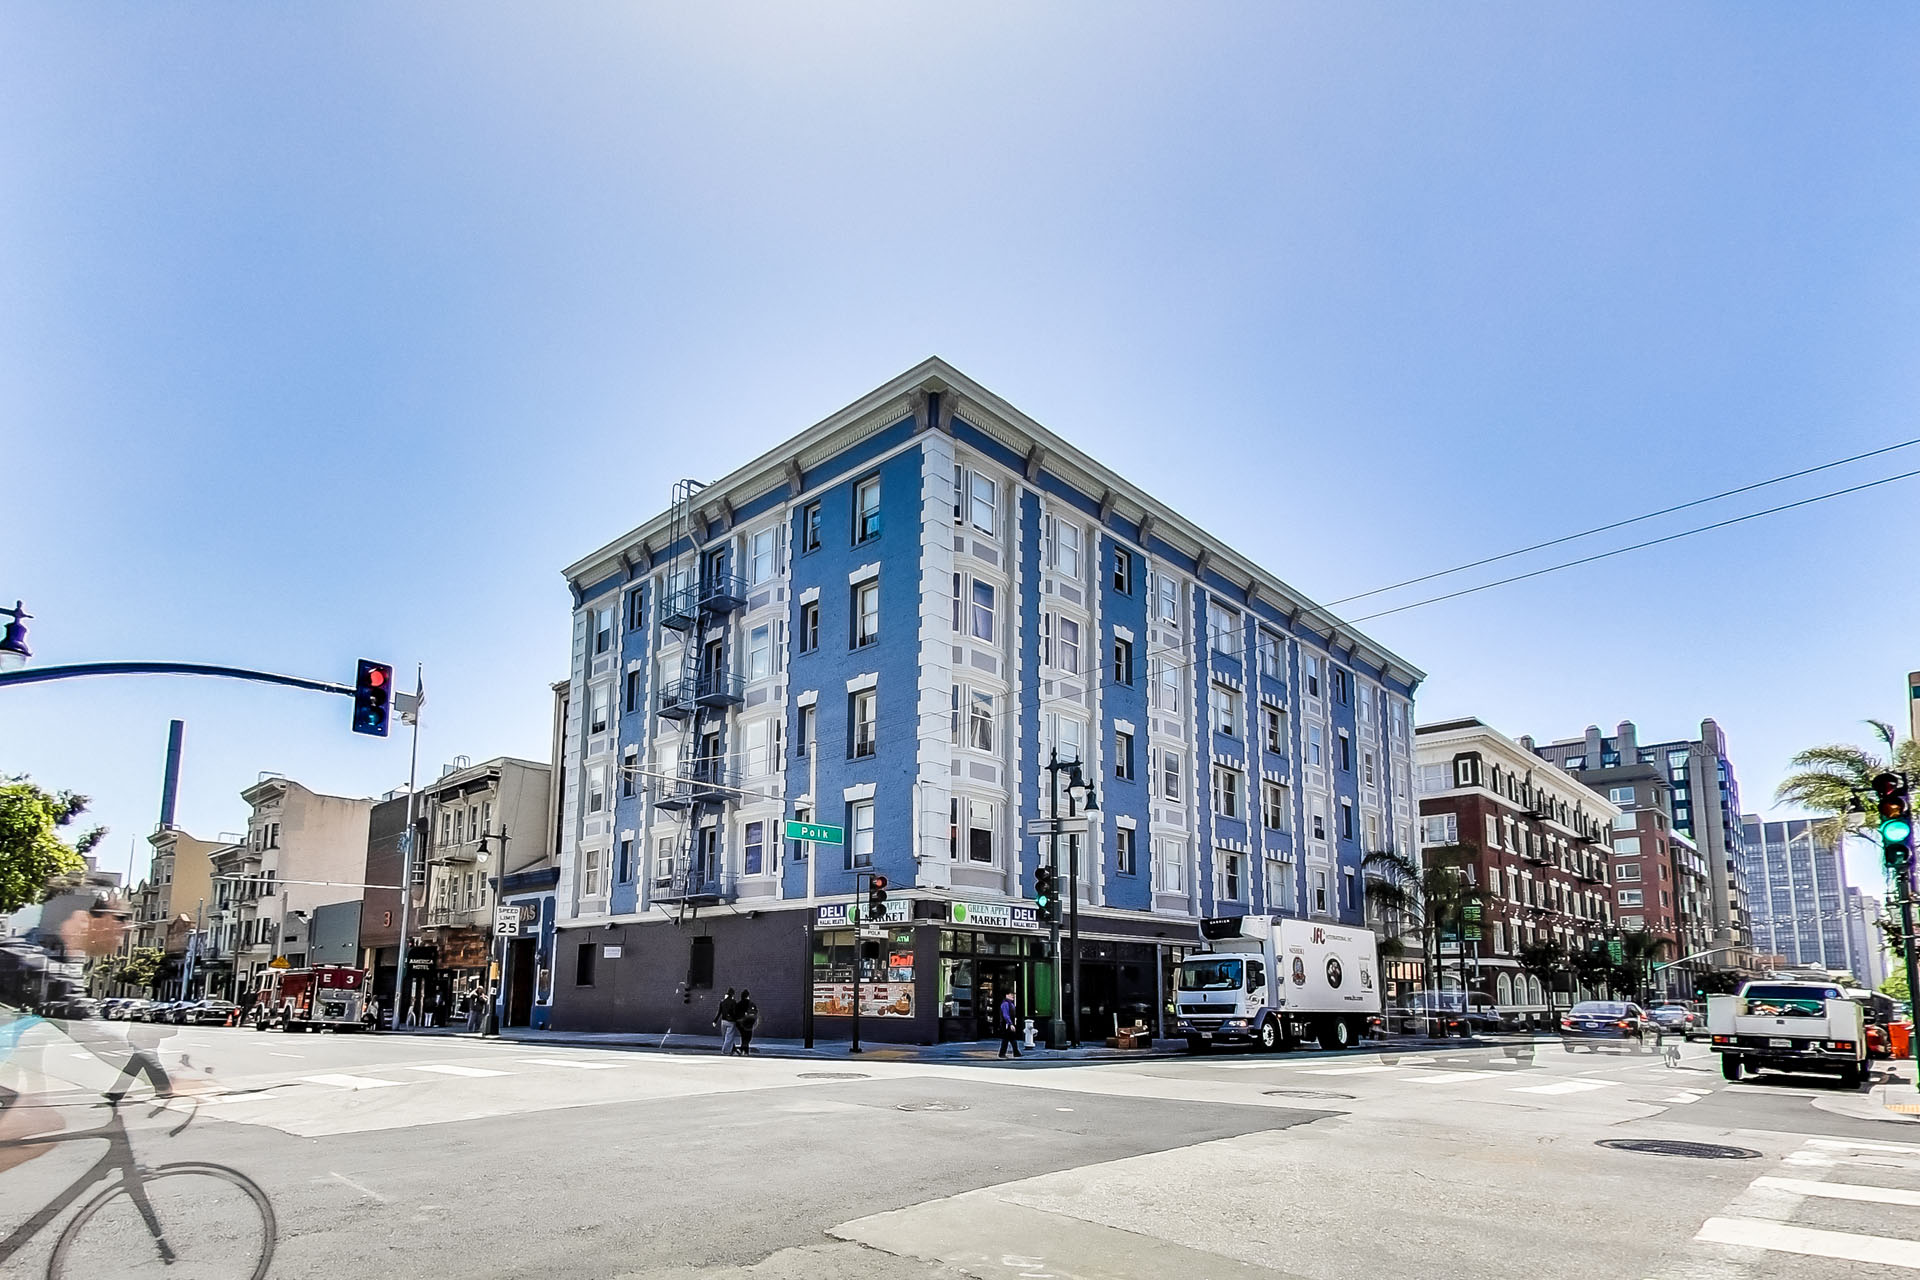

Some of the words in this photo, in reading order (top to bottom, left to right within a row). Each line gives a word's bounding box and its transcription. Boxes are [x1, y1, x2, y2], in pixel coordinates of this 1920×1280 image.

[801, 826, 828, 839] Polk
[820, 905, 844, 918] DELI
[886, 900, 906, 911] APPLE
[967, 904, 989, 914] GREEN
[991, 906, 1009, 916] APPLE
[383, 911, 392, 928] 3
[970, 914, 1008, 926] MARKET
[1014, 908, 1036, 921] DELI
[497, 922, 517, 934] 25
[896, 935, 910, 943] ATM
[1310, 927, 1326, 945] JFC
[323, 973, 333, 983] E
[346, 975, 355, 984] 3
